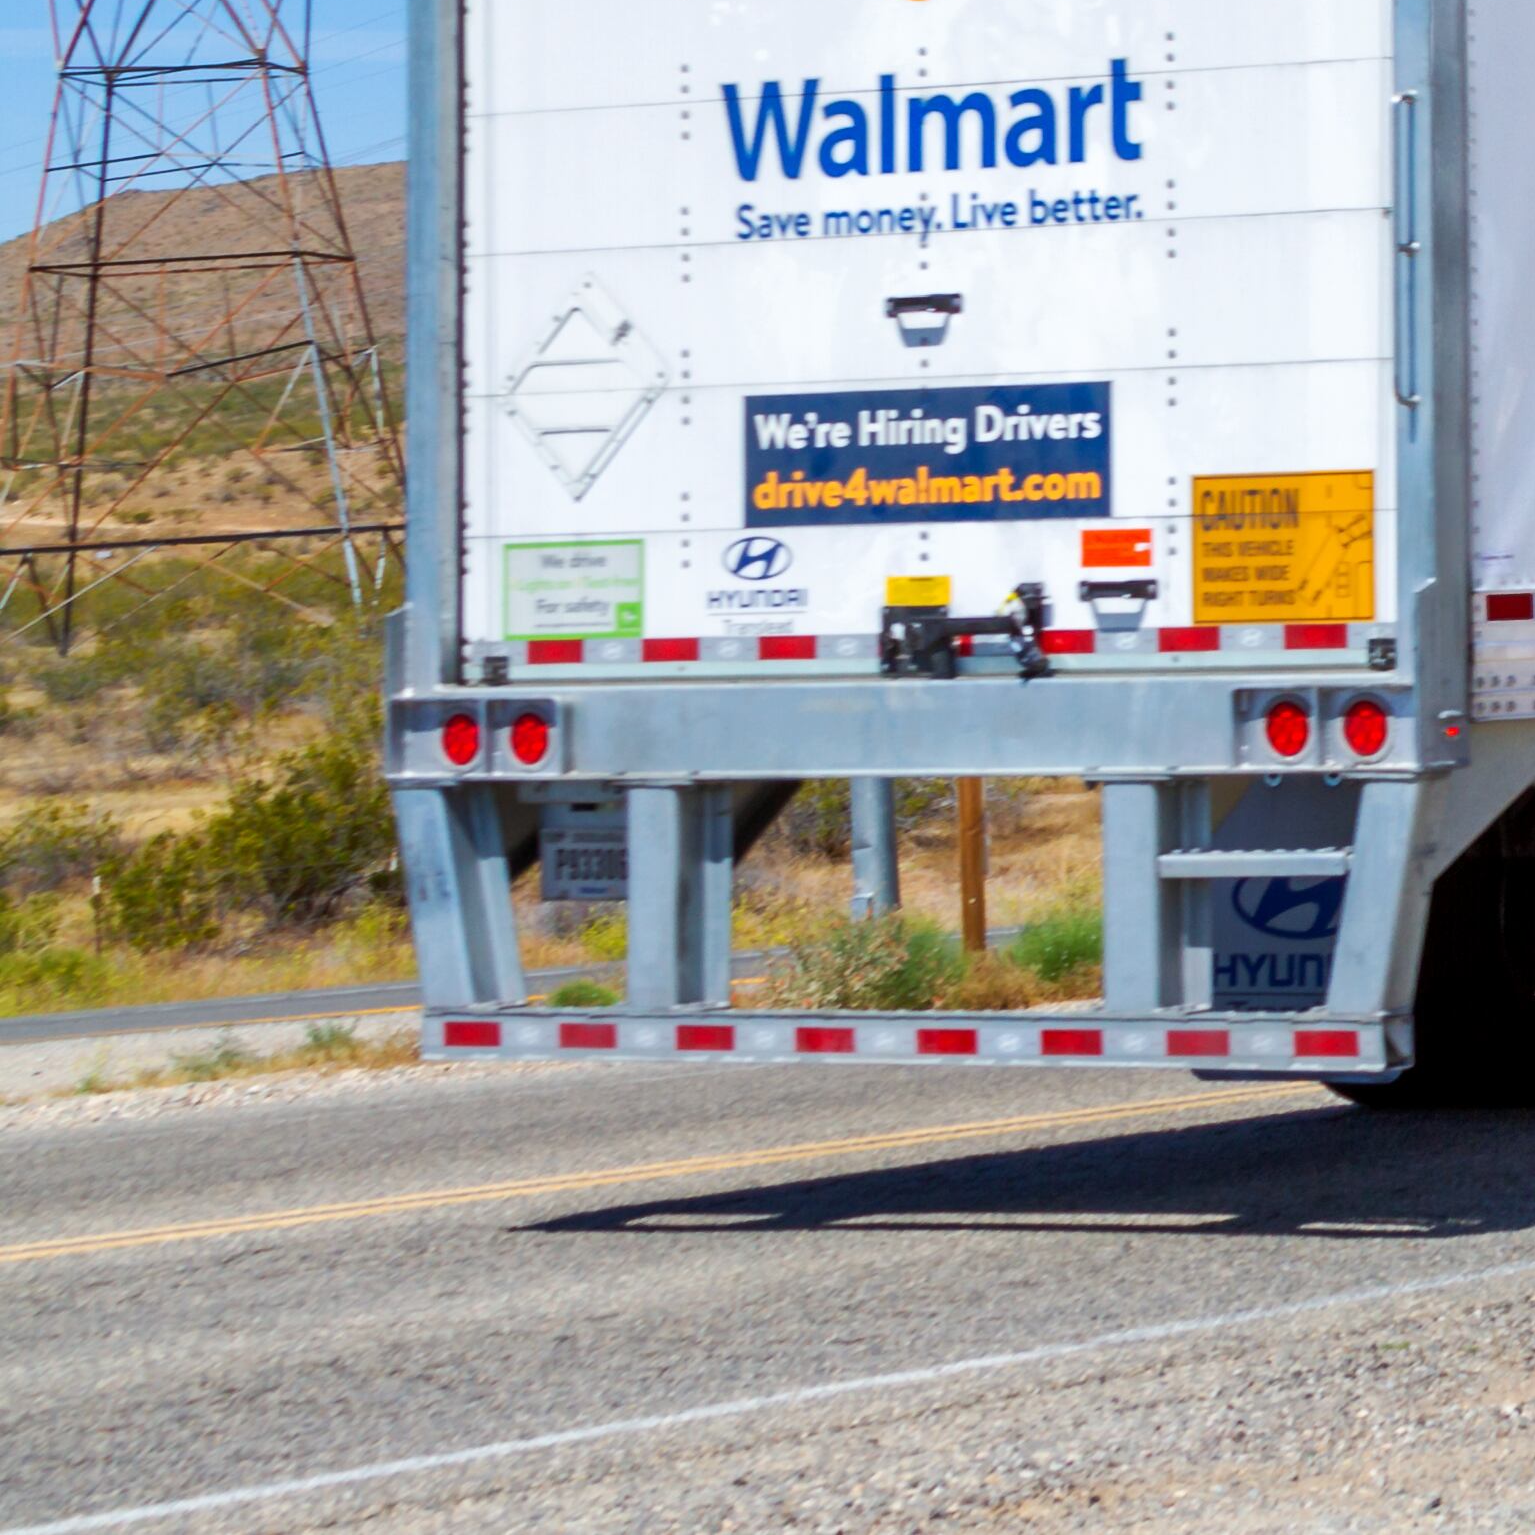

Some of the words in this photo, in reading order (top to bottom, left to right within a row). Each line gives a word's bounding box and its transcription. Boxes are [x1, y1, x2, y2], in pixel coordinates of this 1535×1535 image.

[720, 59, 1142, 181] Walmart
[735, 204, 811, 240] Save
[822, 205, 942, 247] money.
[951, 193, 1017, 230] Live
[1029, 189, 1143, 225] better.
[753, 412, 850, 450] We're
[858, 409, 967, 454] Hiring
[975, 405, 1101, 443] Drivers
[753, 466, 1101, 509] drive4walmart.com
[1203, 488, 1299, 531] CAUTION
[1203, 541, 1233, 557] THIS
[1238, 539, 1294, 557] VEHICLE
[1203, 566, 1249, 583] MAKES
[1255, 565, 1289, 582] WIDE
[706, 589, 808, 609] HYUNDAI
[1203, 591, 1244, 607] RIGHT
[1249, 590, 1296, 606] TURNS
[1213, 953, 1333, 988] HYUN
